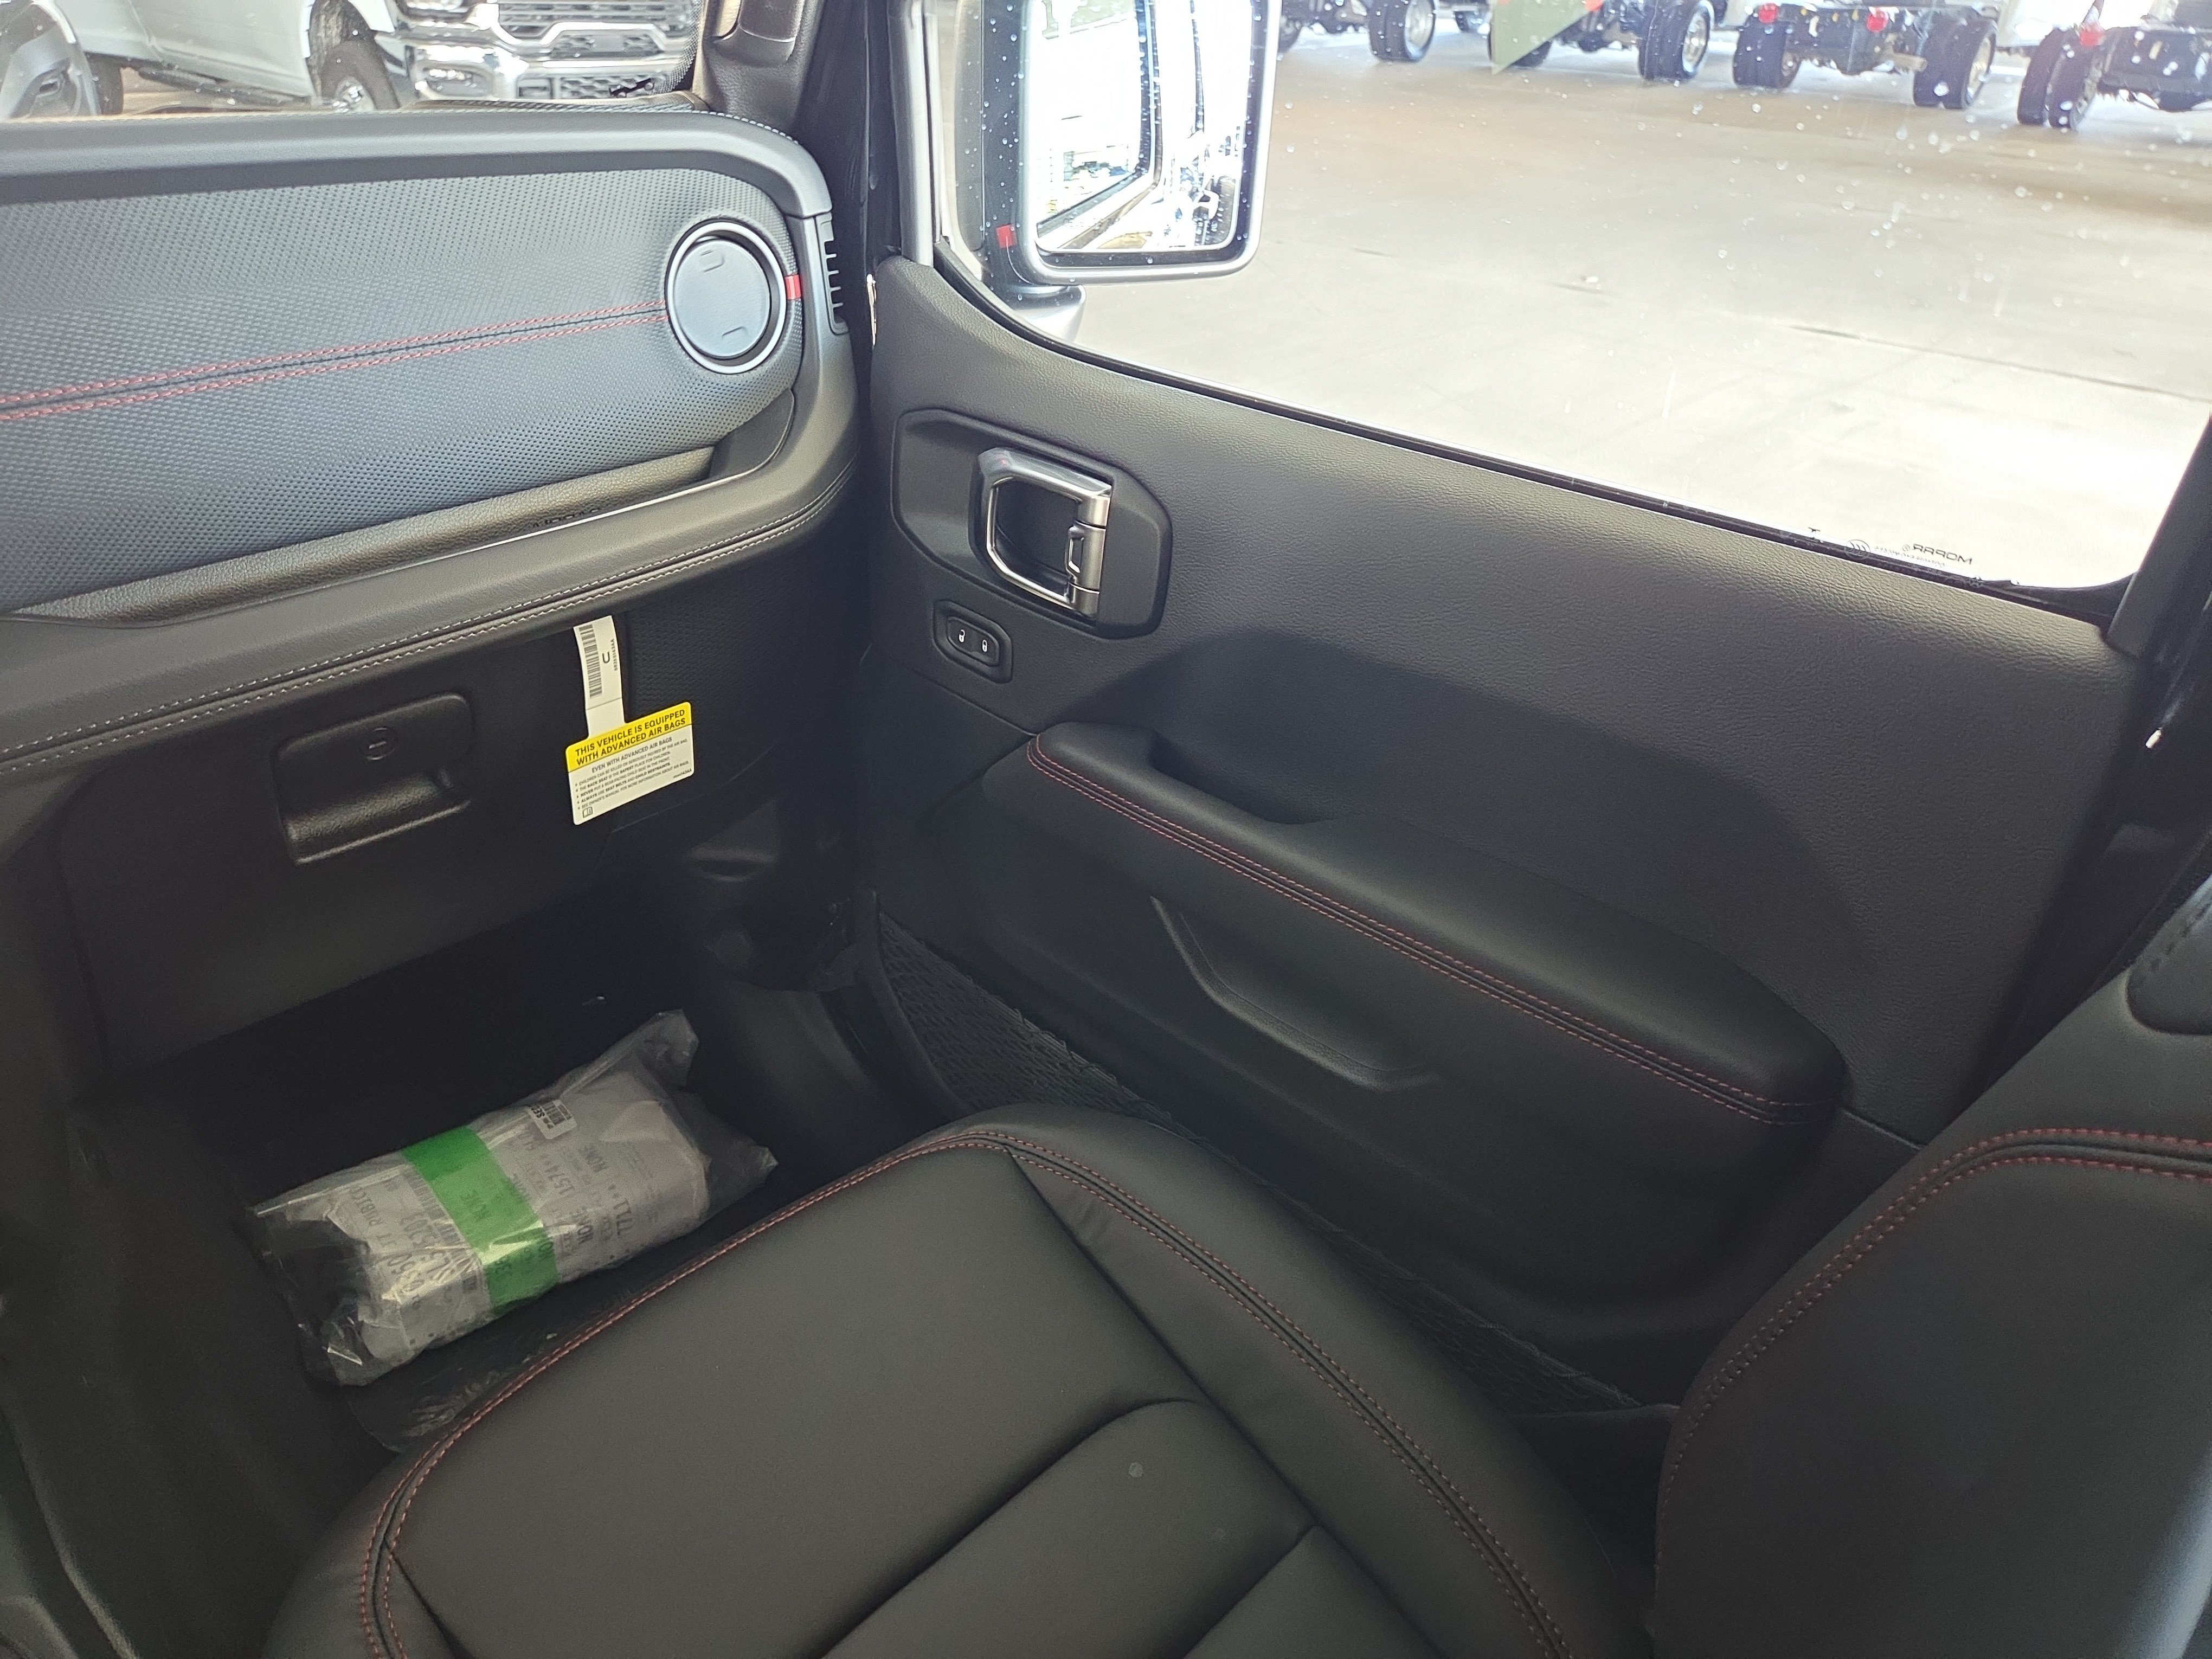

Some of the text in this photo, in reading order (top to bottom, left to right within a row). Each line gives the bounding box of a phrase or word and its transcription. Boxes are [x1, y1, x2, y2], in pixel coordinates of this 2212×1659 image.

[602, 652, 610, 664] U
[576, 708, 685, 756] THIS VEHICLE IS EQUIPPED
[577, 717, 685, 766] WITH ADVANCED AIR BAGS
[591, 763, 605, 773] EVEN
[606, 757, 619, 766] WITH
[621, 745, 648, 761] ADVANCED
[659, 736, 672, 745] BAGS
[620, 766, 633, 774] SAFEST
[581, 793, 597, 802] ALWAYS
